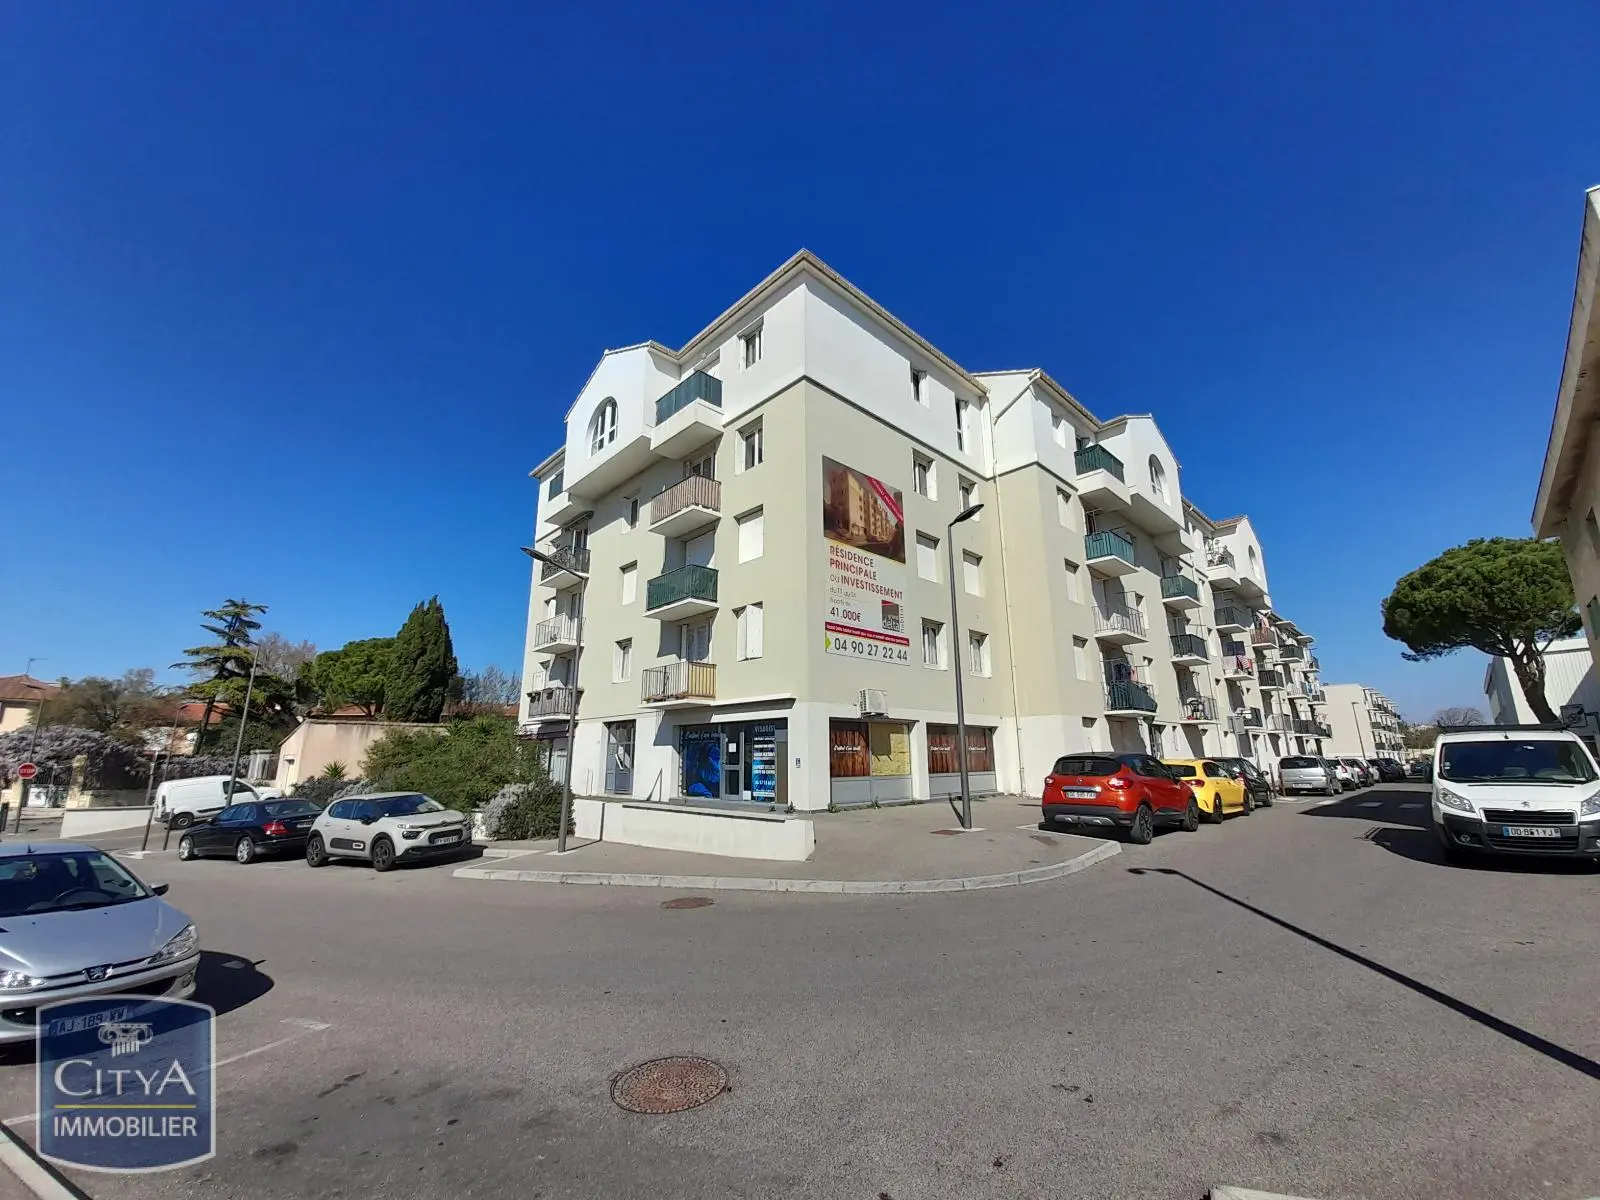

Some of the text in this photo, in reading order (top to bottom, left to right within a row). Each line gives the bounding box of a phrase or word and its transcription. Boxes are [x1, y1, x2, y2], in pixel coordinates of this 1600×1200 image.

[829, 545, 874, 568] RÉSIDENCE
[829, 558, 877, 580] PRINCIPALE
[841, 575, 903, 599] INVESTISSEMENT
[830, 606, 861, 622] 41.000€
[834, 637, 908, 662] 04 90 27 22 44
